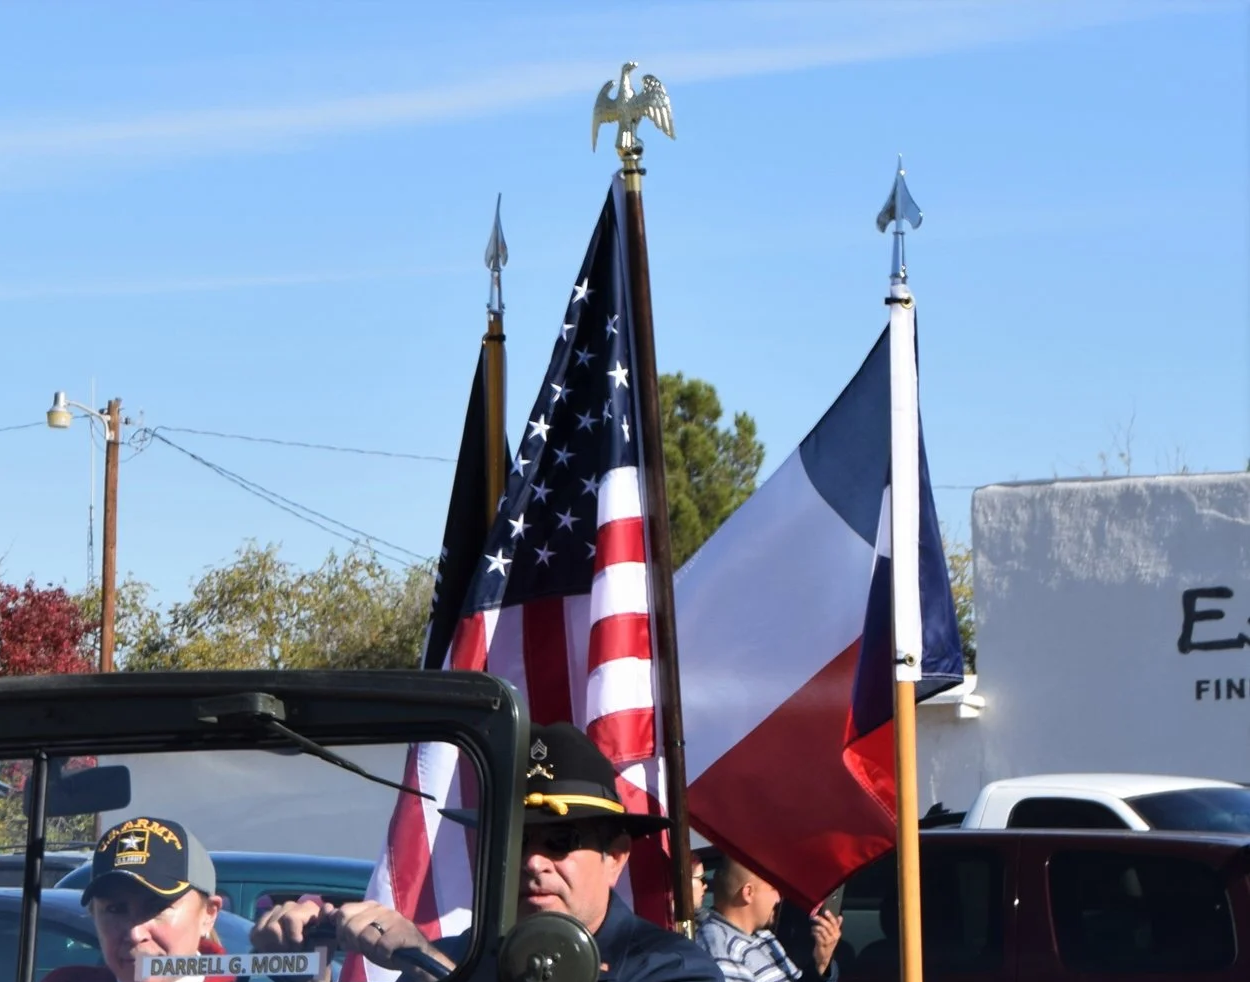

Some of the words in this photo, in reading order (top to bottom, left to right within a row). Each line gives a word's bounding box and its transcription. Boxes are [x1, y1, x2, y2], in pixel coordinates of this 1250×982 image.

[1177, 586, 1250, 654] E
[1195, 678, 1250, 700] FIN
[121, 818, 183, 850] ARMY
[150, 956, 225, 977] DARRELL
[228, 956, 247, 975] G.
[251, 955, 309, 974] MOND
